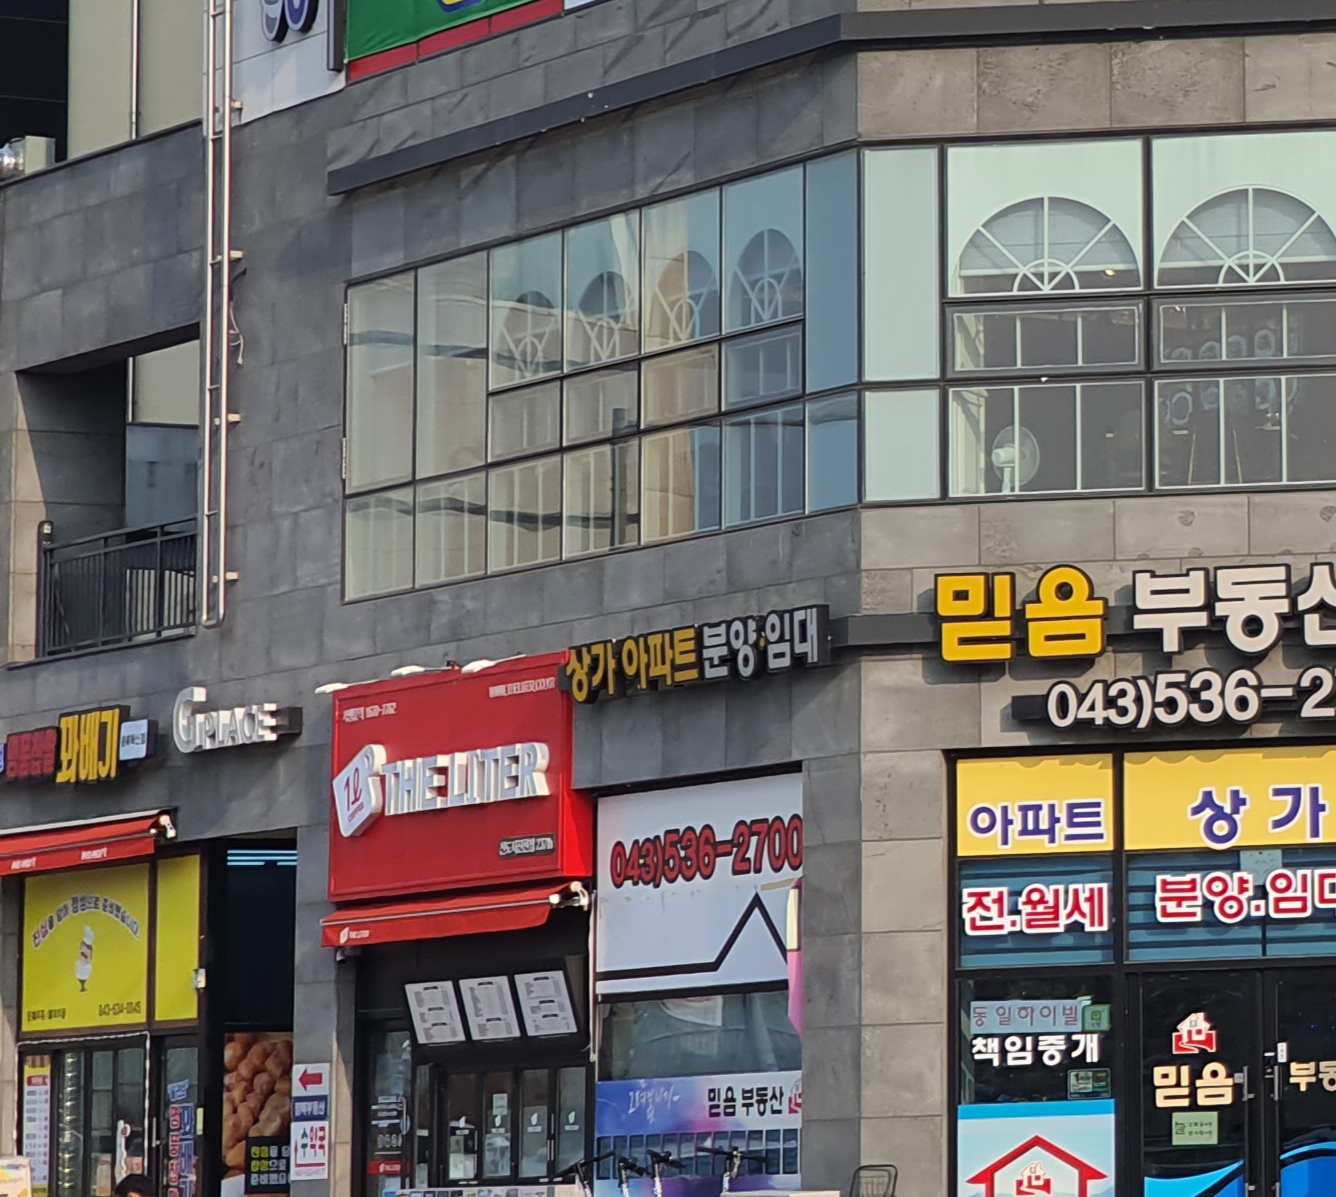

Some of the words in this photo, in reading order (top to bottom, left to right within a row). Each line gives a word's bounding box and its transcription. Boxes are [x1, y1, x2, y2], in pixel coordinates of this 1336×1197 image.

[936, 565, 1108, 662] 믿음
[567, 642, 617, 702] 상가
[621, 629, 699, 690] 아파트
[969, 799, 1107, 847] 아파트
[609, 813, 803, 890] 043)536-2700
[971, 1033, 1100, 1068] 책임중개
[707, 1085, 737, 1117] 믿음
[741, 1085, 784, 1118] 부동산
[1152, 1061, 1234, 1108] 믿음
